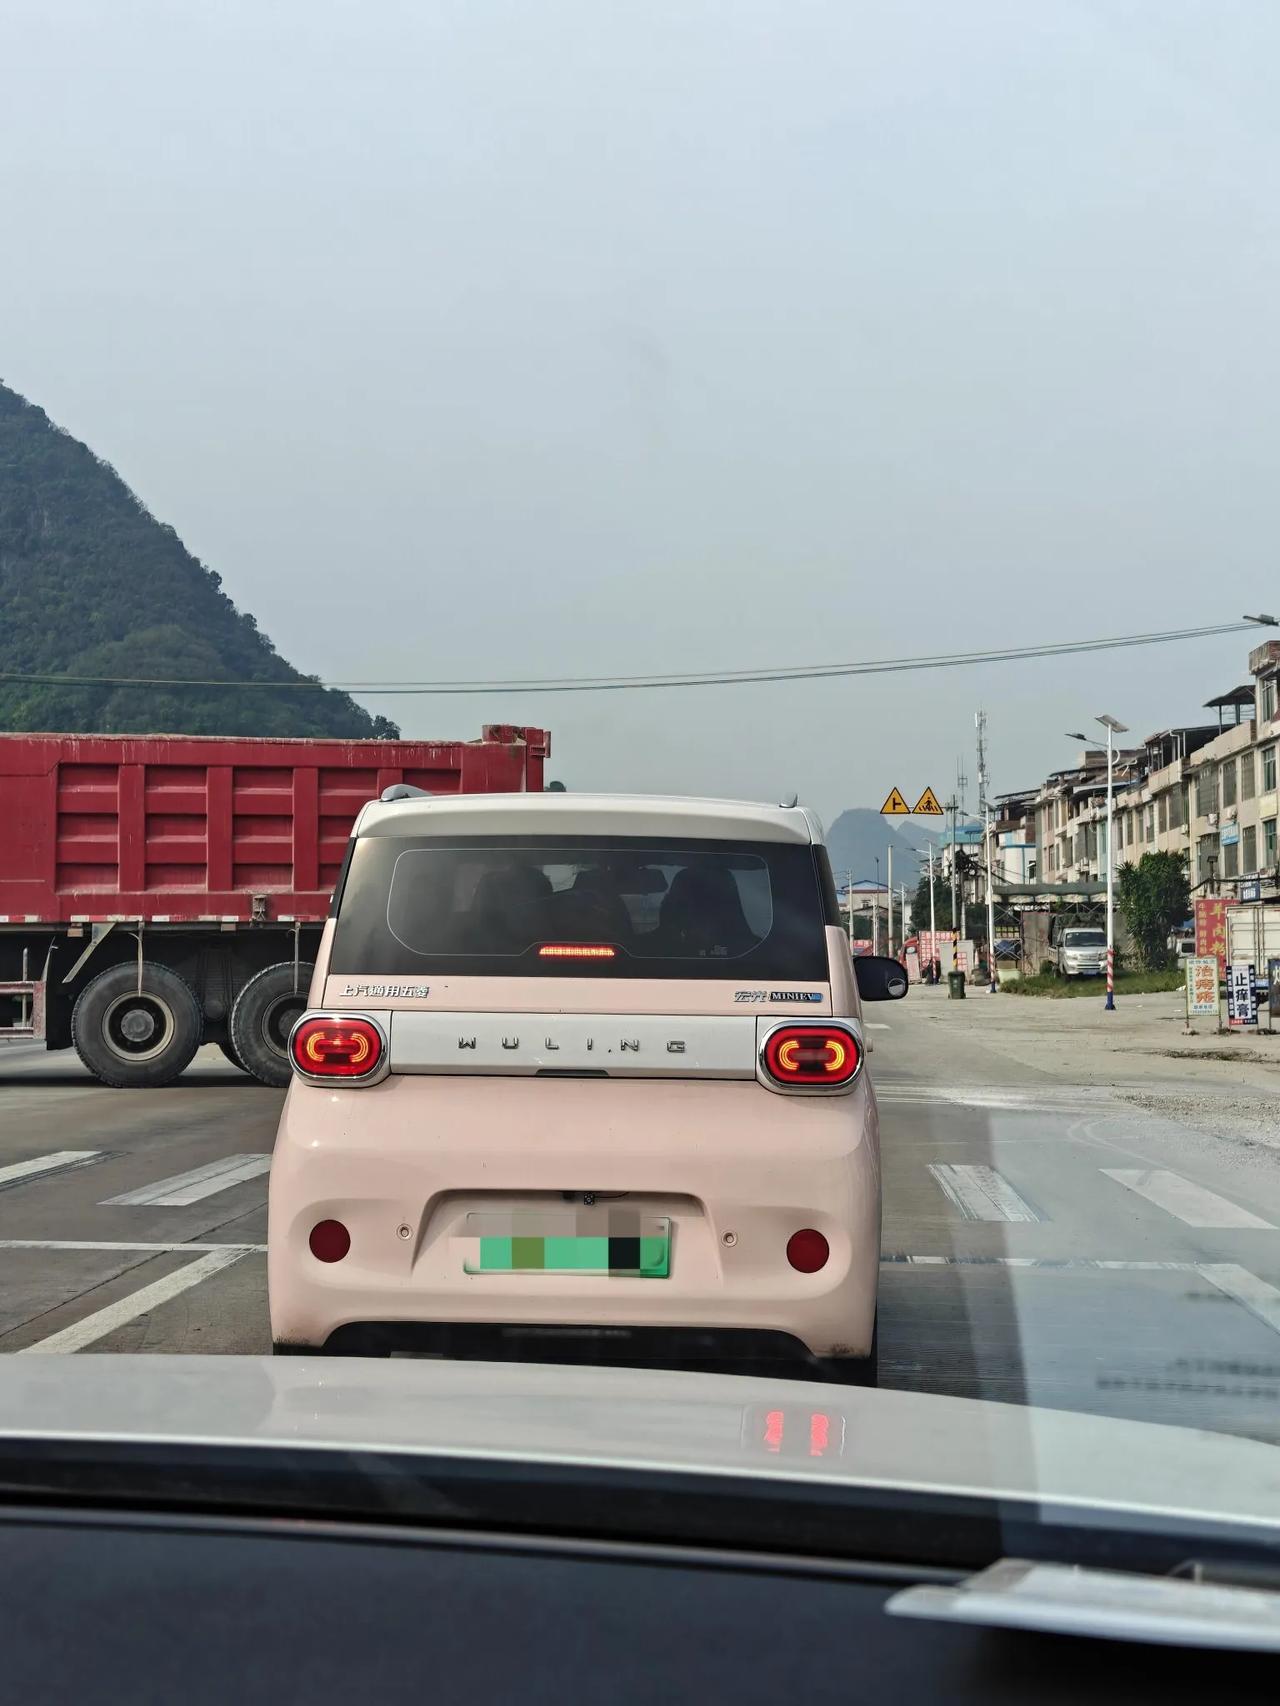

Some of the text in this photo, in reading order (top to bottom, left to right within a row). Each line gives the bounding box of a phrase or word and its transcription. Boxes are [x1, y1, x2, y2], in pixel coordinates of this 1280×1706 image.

[339, 984, 430, 999] 上汽通用五菱
[1235, 972, 1249, 1017] 止痒膏
[458, 1036, 685, 1053] WULING
